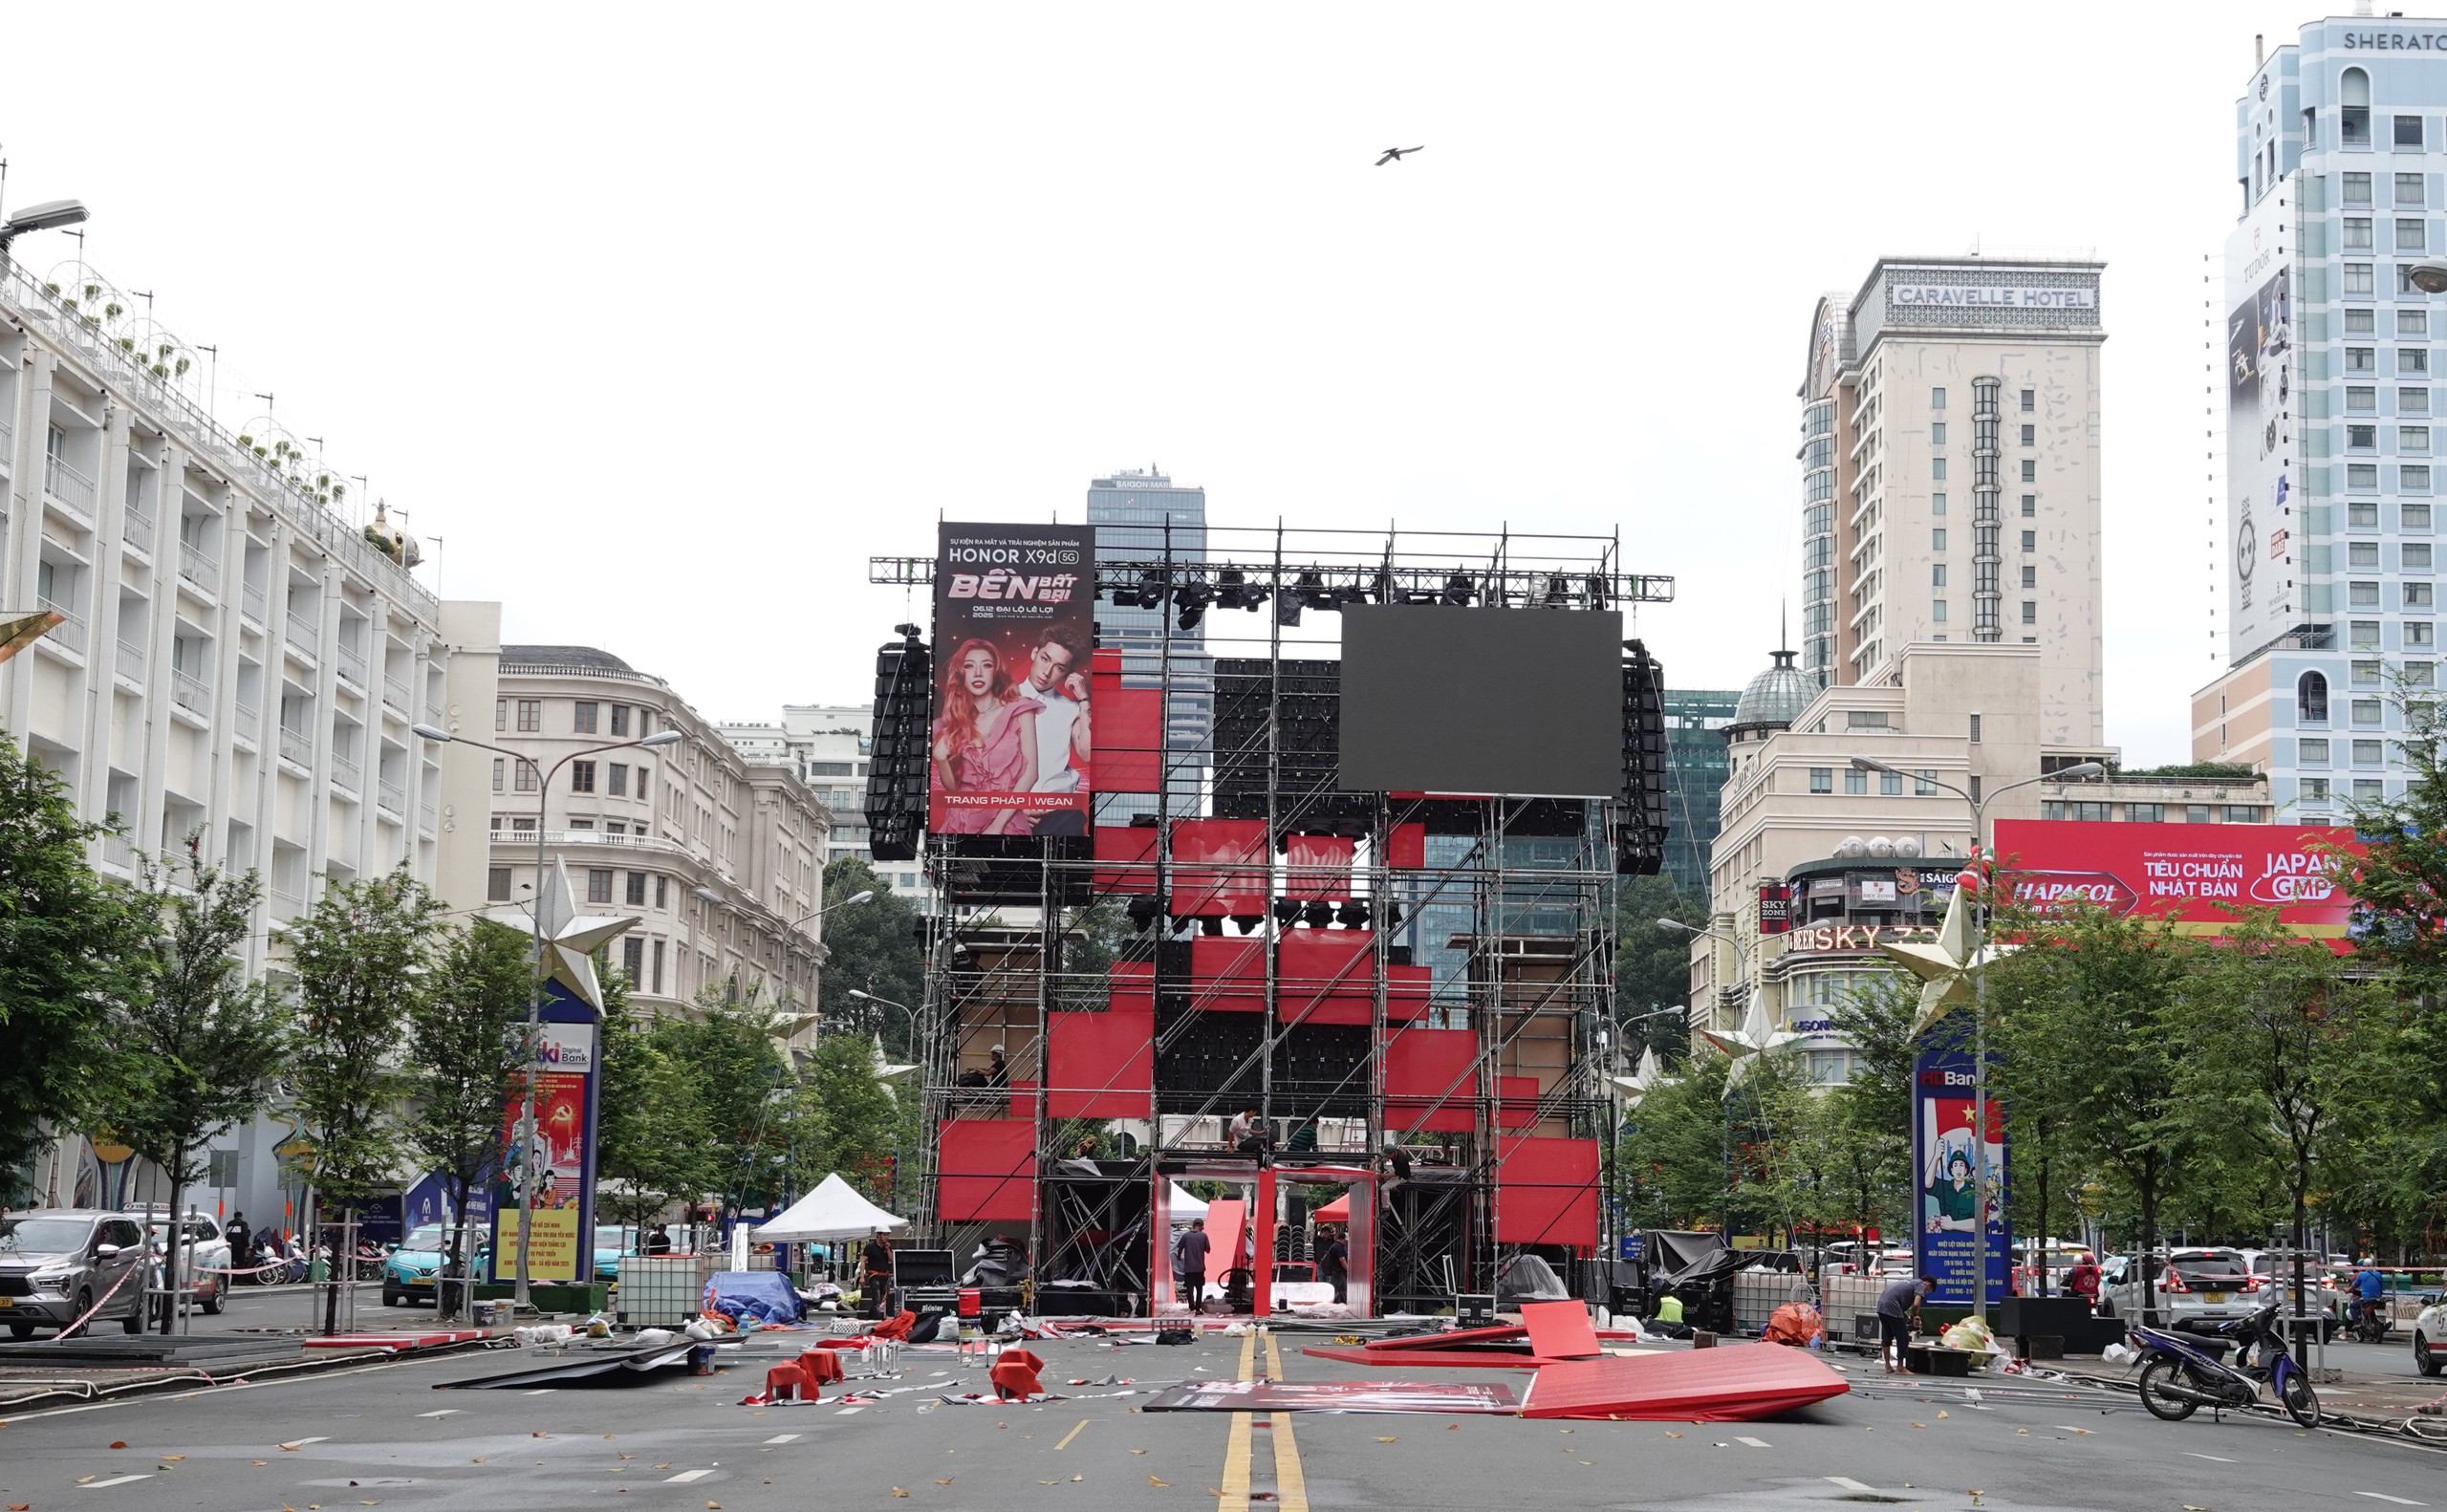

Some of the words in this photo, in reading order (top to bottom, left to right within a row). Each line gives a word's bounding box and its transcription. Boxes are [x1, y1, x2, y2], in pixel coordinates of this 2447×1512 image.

[2344, 32, 2447, 51] SHERATO
[2243, 248, 2270, 283] TUDOR
[1898, 288, 2015, 306] CARAVELLE
[2024, 290, 2090, 307] HOTEL
[949, 548, 1020, 563] HONOR
[1025, 549, 1057, 564] X9d
[1062, 552, 1075, 562] 5G
[948, 568, 1041, 600] BỀN
[996, 606, 1011, 615] ĐẠI
[1012, 605, 1025, 615] LỘ
[944, 795, 988, 805] TRANG
[990, 794, 1026, 805] PHÁP
[1034, 797, 1073, 806] WEAN
[2144, 859, 2179, 877] TIÊU
[2182, 858, 2243, 878] CHUẨN
[2262, 853, 2343, 878] JAPAN
[1926, 873, 1959, 884] SAIGO
[2150, 878, 2198, 898] NHẬT
[2200, 878, 2238, 896] BẢN
[2276, 877, 2328, 897] GMP
[1762, 900, 1787, 909] SKY
[1793, 929, 1815, 951] BEER
[1816, 925, 1880, 950] SKY
[1920, 1070, 1977, 1086] HDBan
